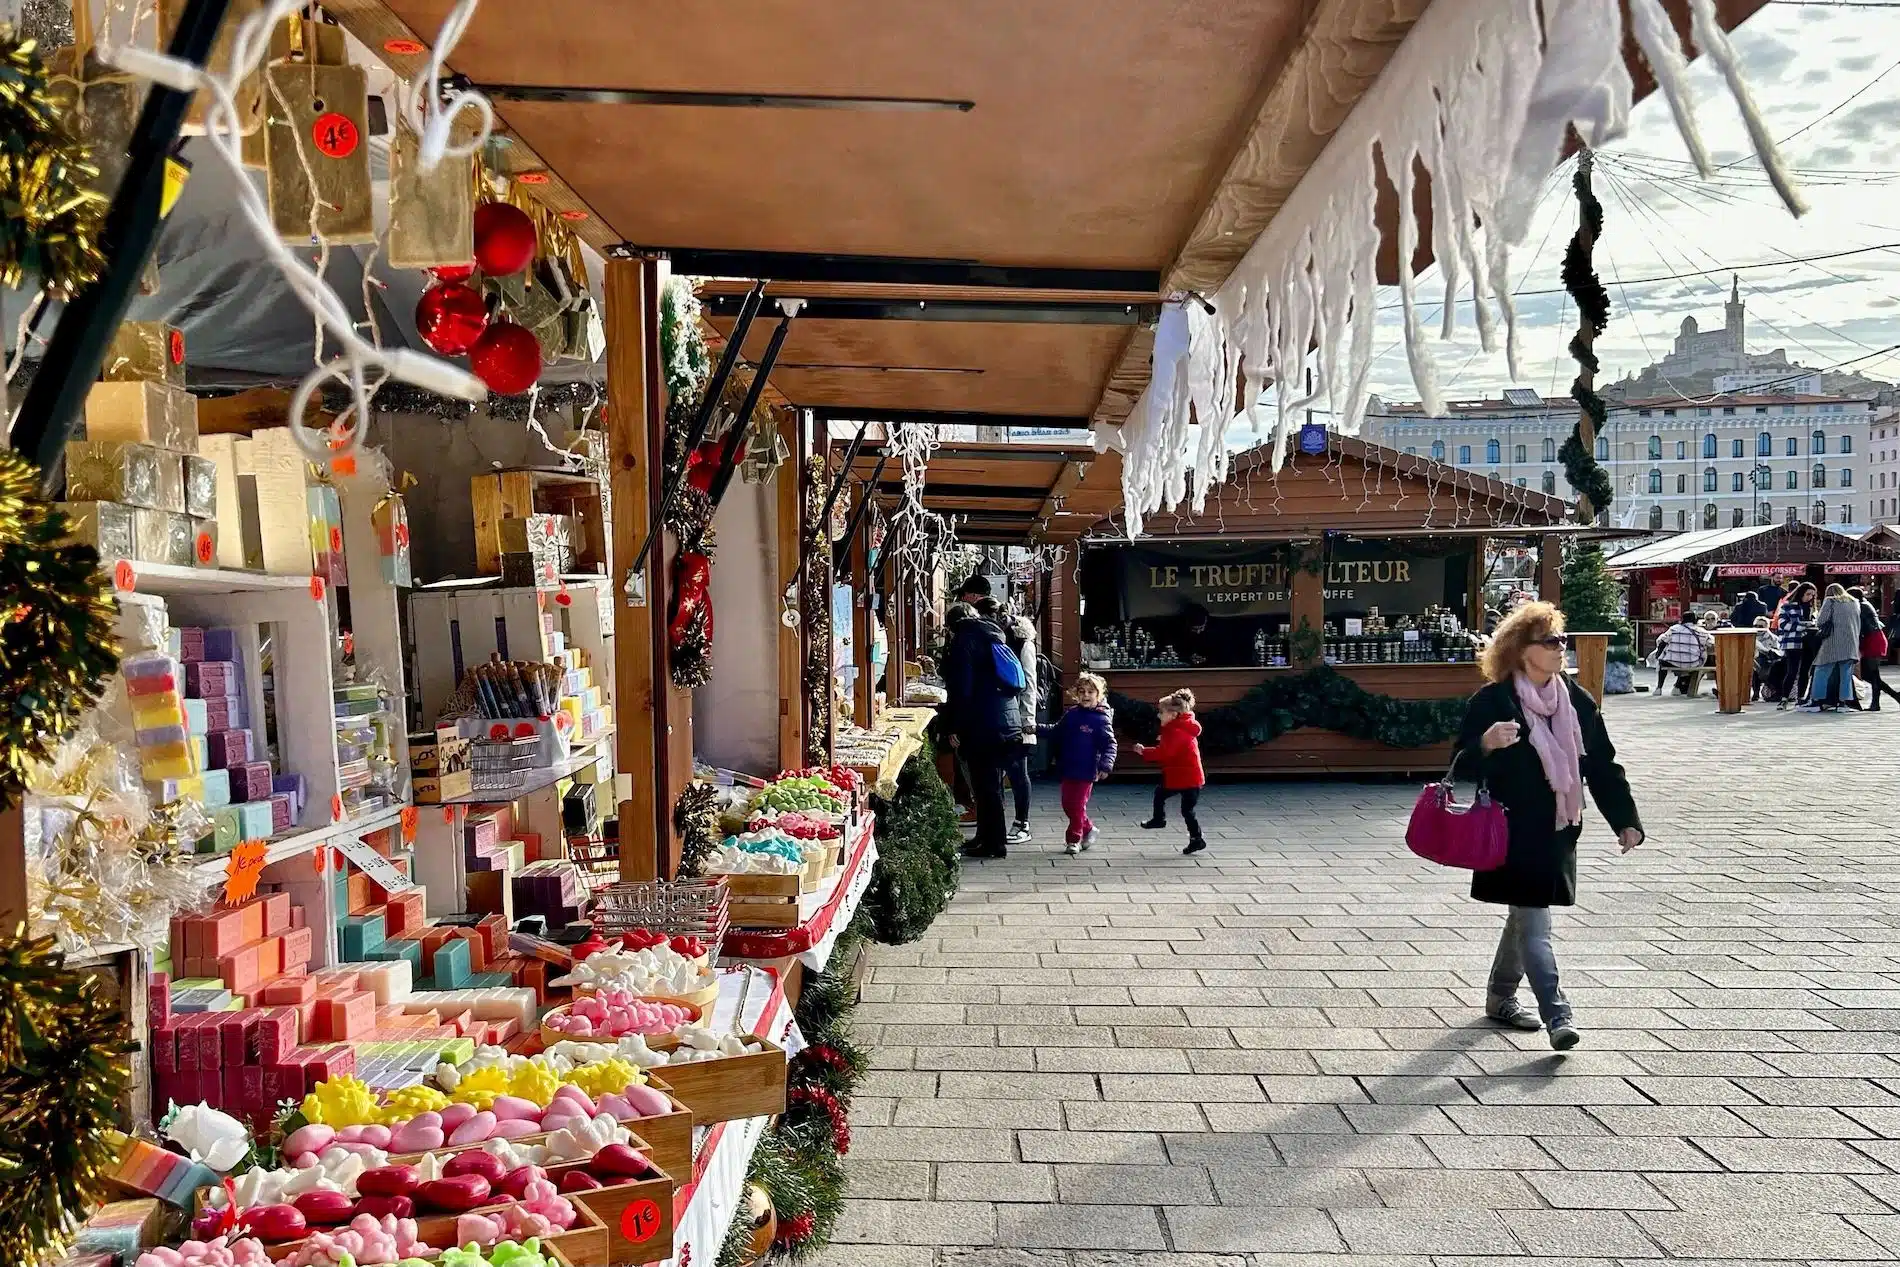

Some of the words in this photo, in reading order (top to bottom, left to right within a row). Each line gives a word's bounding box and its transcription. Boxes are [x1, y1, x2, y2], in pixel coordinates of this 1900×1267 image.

[323, 120, 350, 151] 4€
[1150, 566, 1179, 588] LE
[1190, 560, 1411, 587] TRUFFILTEUR
[1207, 591, 1263, 603] L'EXPERT
[1267, 591, 1283, 600] DE
[632, 1205, 654, 1237] 1€
